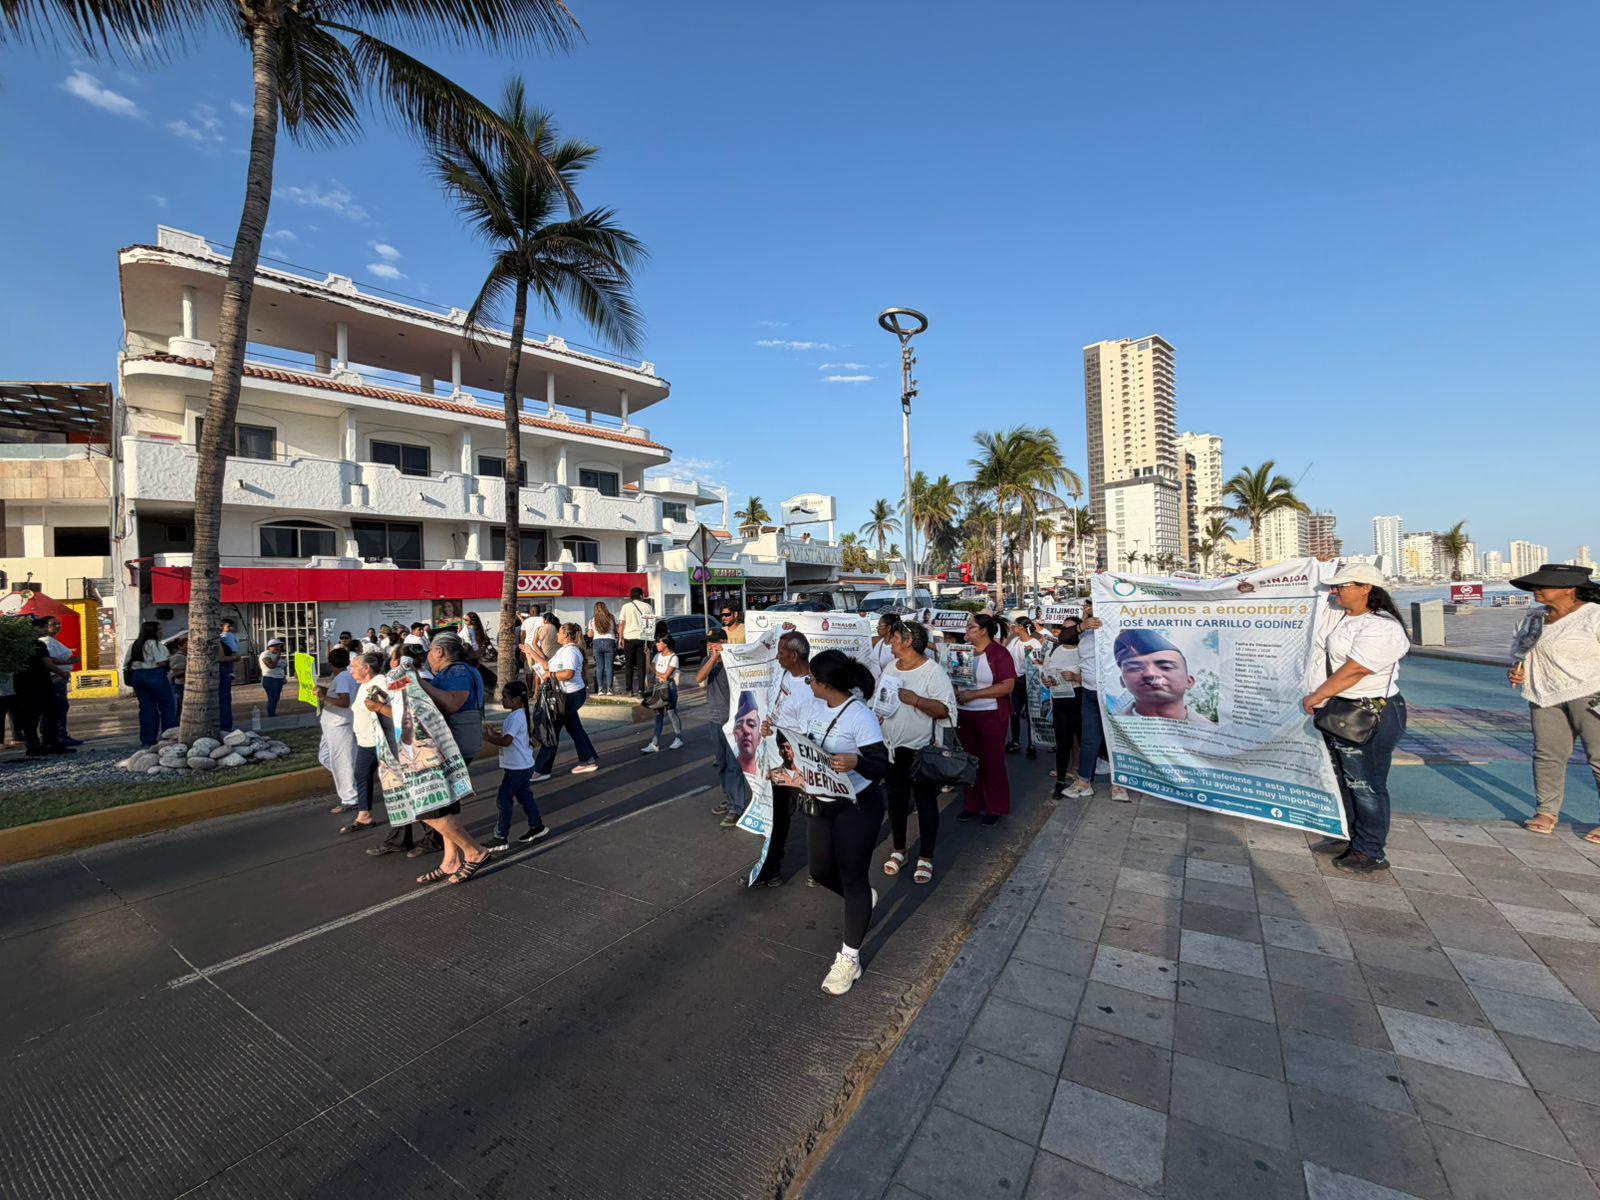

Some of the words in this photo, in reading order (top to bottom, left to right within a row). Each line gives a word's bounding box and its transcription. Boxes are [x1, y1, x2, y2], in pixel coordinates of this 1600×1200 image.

[517, 575, 561, 591] OXXO
[1259, 575, 1308, 585] SINALOA
[1140, 587, 1182, 597] Sinaloa
[1046, 607, 1080, 615] EXIJIMOS
[1120, 604, 1196, 617] Ayúdanos
[1202, 606, 1211, 614] a
[1216, 604, 1296, 614] encontrar
[1299, 605, 1308, 614] a
[1119, 618, 1144, 627] JOSÉ
[1147, 619, 1192, 627] MARTIN
[1195, 619, 1251, 628] CARRILLO
[1255, 618, 1304, 629] GODÍNEZ
[803, 766, 849, 795] LIBERTAD
[1202, 778, 1212, 786] Tu
[1214, 781, 1241, 792] ayuda
[1256, 790, 1276, 799] muy
[1266, 782, 1285, 792] esta
